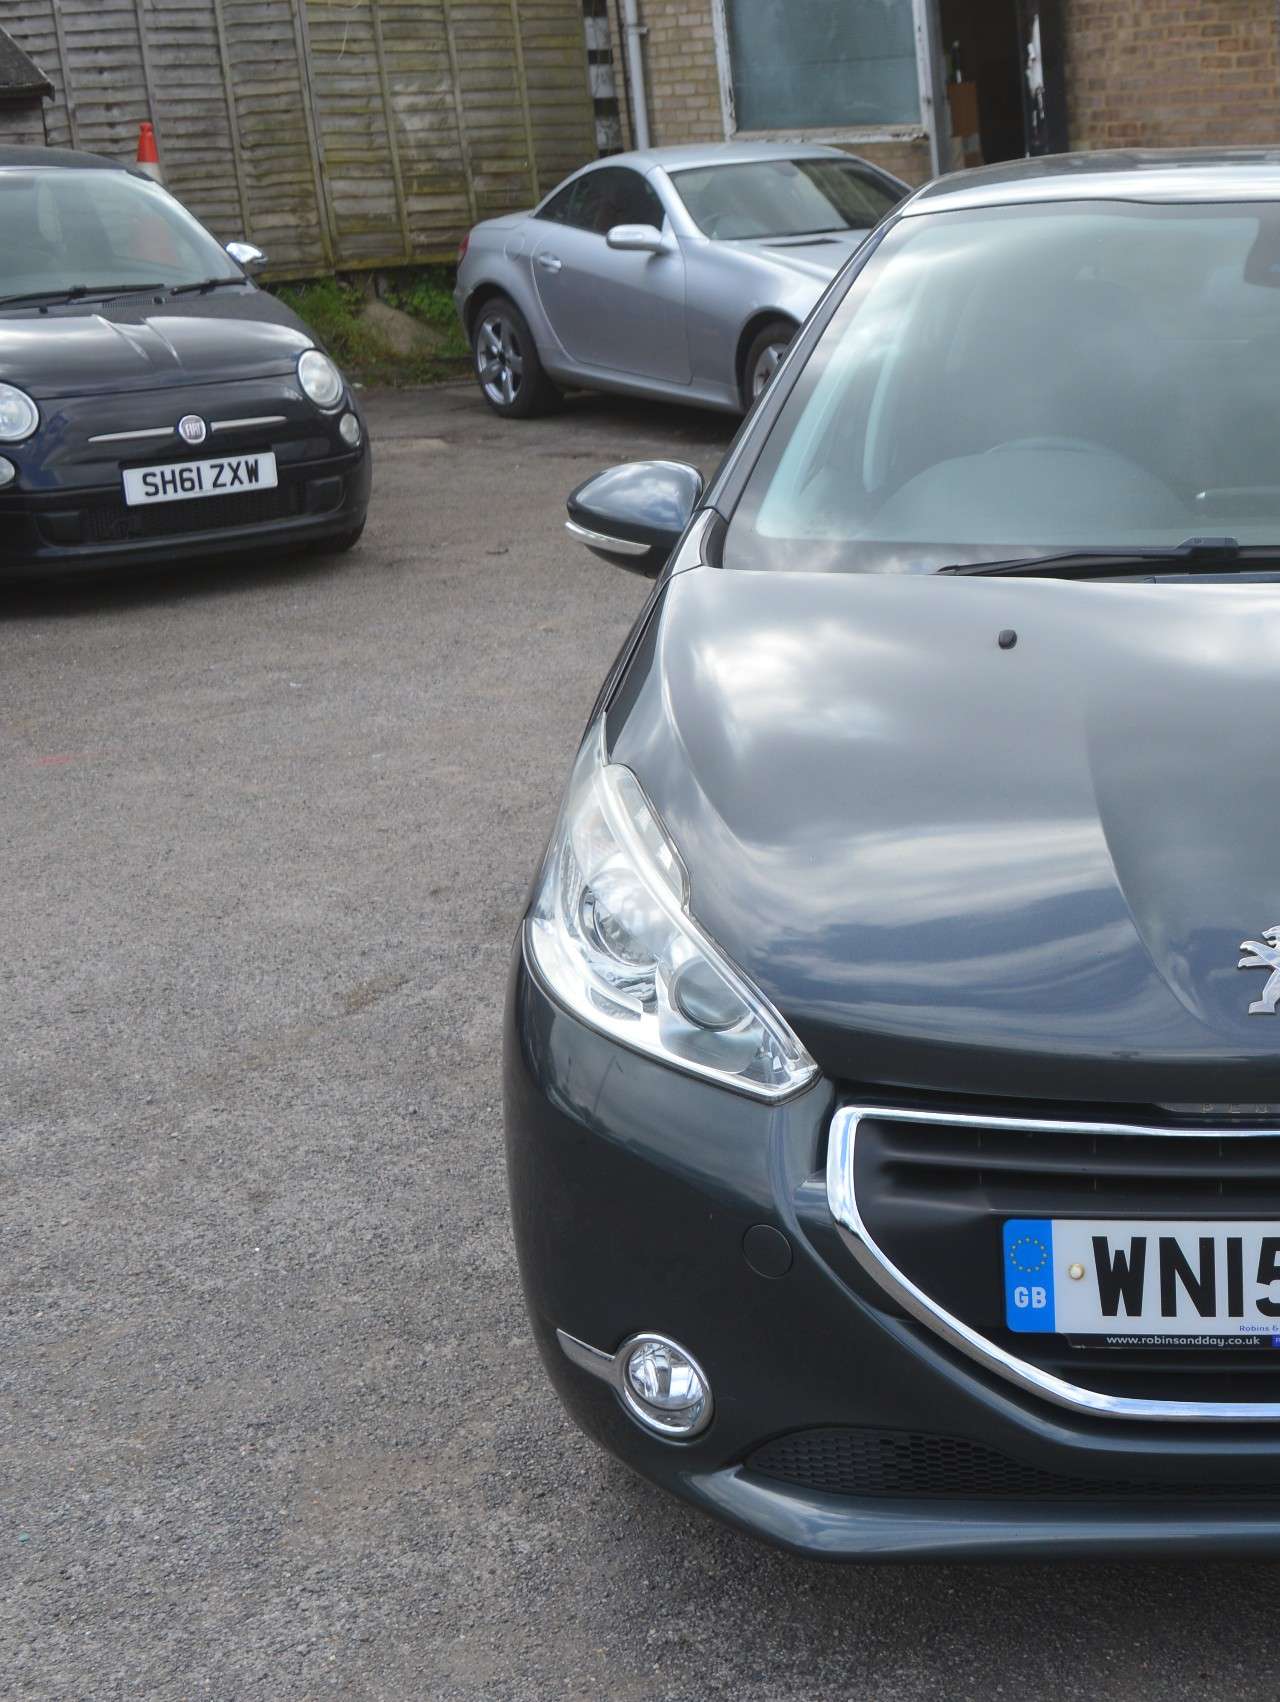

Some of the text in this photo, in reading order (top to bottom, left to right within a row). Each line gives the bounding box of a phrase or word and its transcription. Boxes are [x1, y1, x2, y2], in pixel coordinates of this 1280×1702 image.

[142, 458, 260, 497] SH61 ZXW
[1014, 1286, 1047, 1309] GB
[1239, 1324, 1270, 1332] Robins
[1106, 1335, 1261, 1347] www.robinsandday.co.uk
